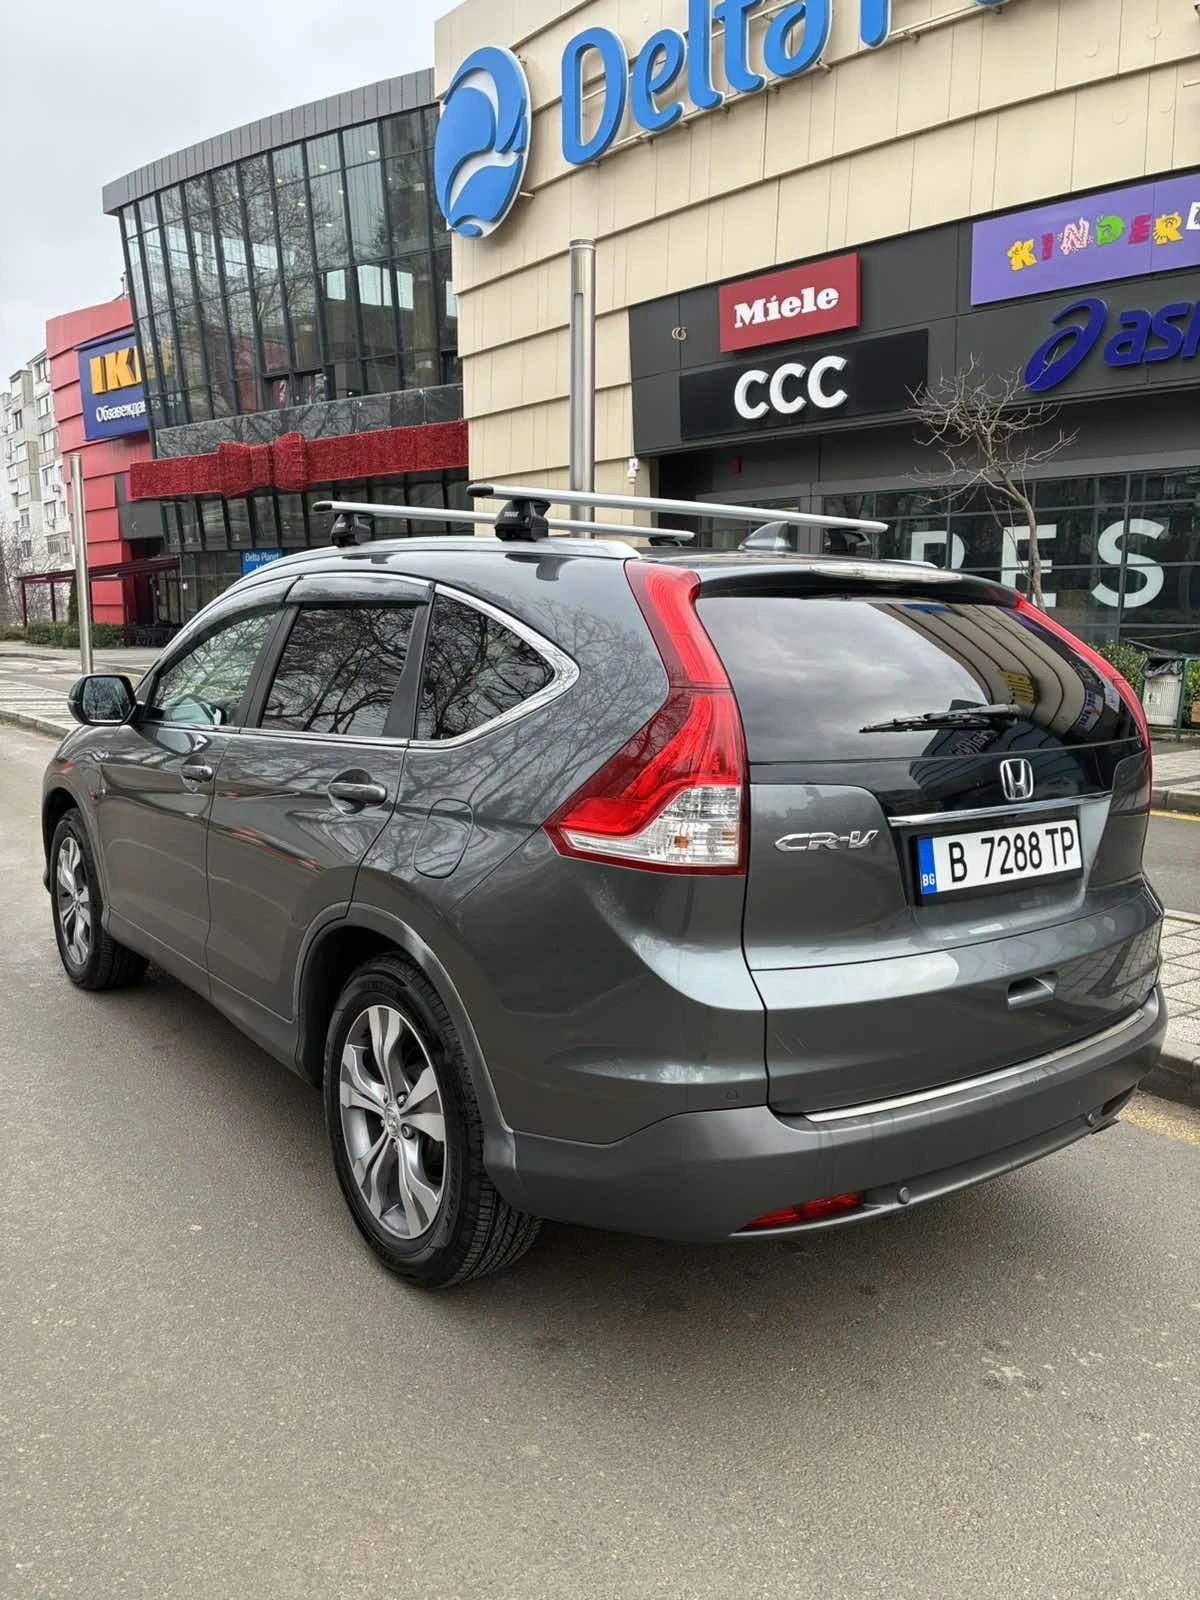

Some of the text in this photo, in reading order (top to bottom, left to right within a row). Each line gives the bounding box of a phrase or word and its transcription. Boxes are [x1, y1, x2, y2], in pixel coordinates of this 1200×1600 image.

[559, 0, 832, 166] Delta
[1007, 202, 1200, 272] KINDER
[734, 286, 839, 328] Miele
[90, 346, 142, 395] IK
[734, 355, 848, 420] CCC
[245, 551, 260, 561] Delta
[774, 829, 879, 852] CR-V
[949, 826, 1075, 883] B 7288 TP
[922, 873, 937, 887] BG
